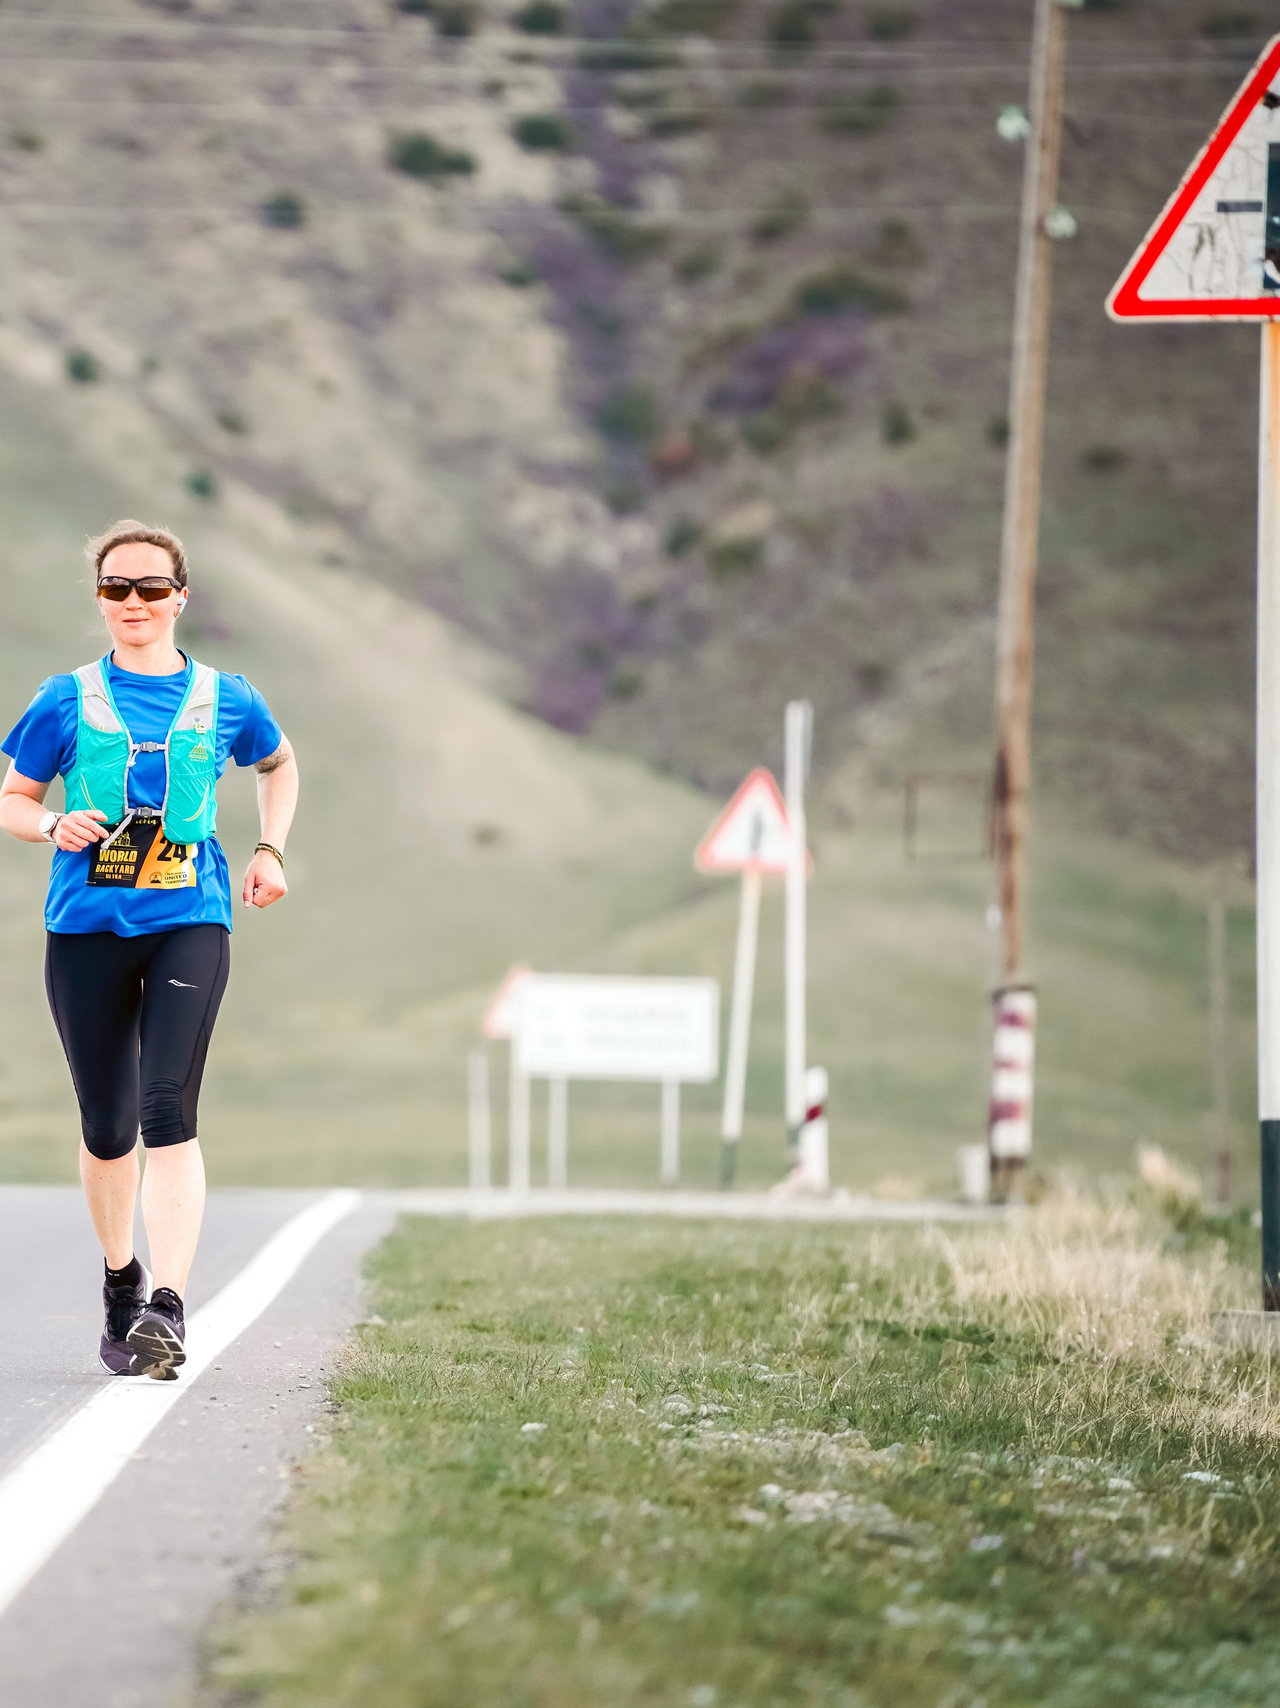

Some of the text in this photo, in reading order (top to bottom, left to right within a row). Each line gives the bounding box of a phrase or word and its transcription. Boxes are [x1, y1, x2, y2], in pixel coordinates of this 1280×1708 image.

[99, 849, 138, 863] WORLD
[157, 835, 188, 863] 24
[95, 864, 135, 875] BACKYARD
